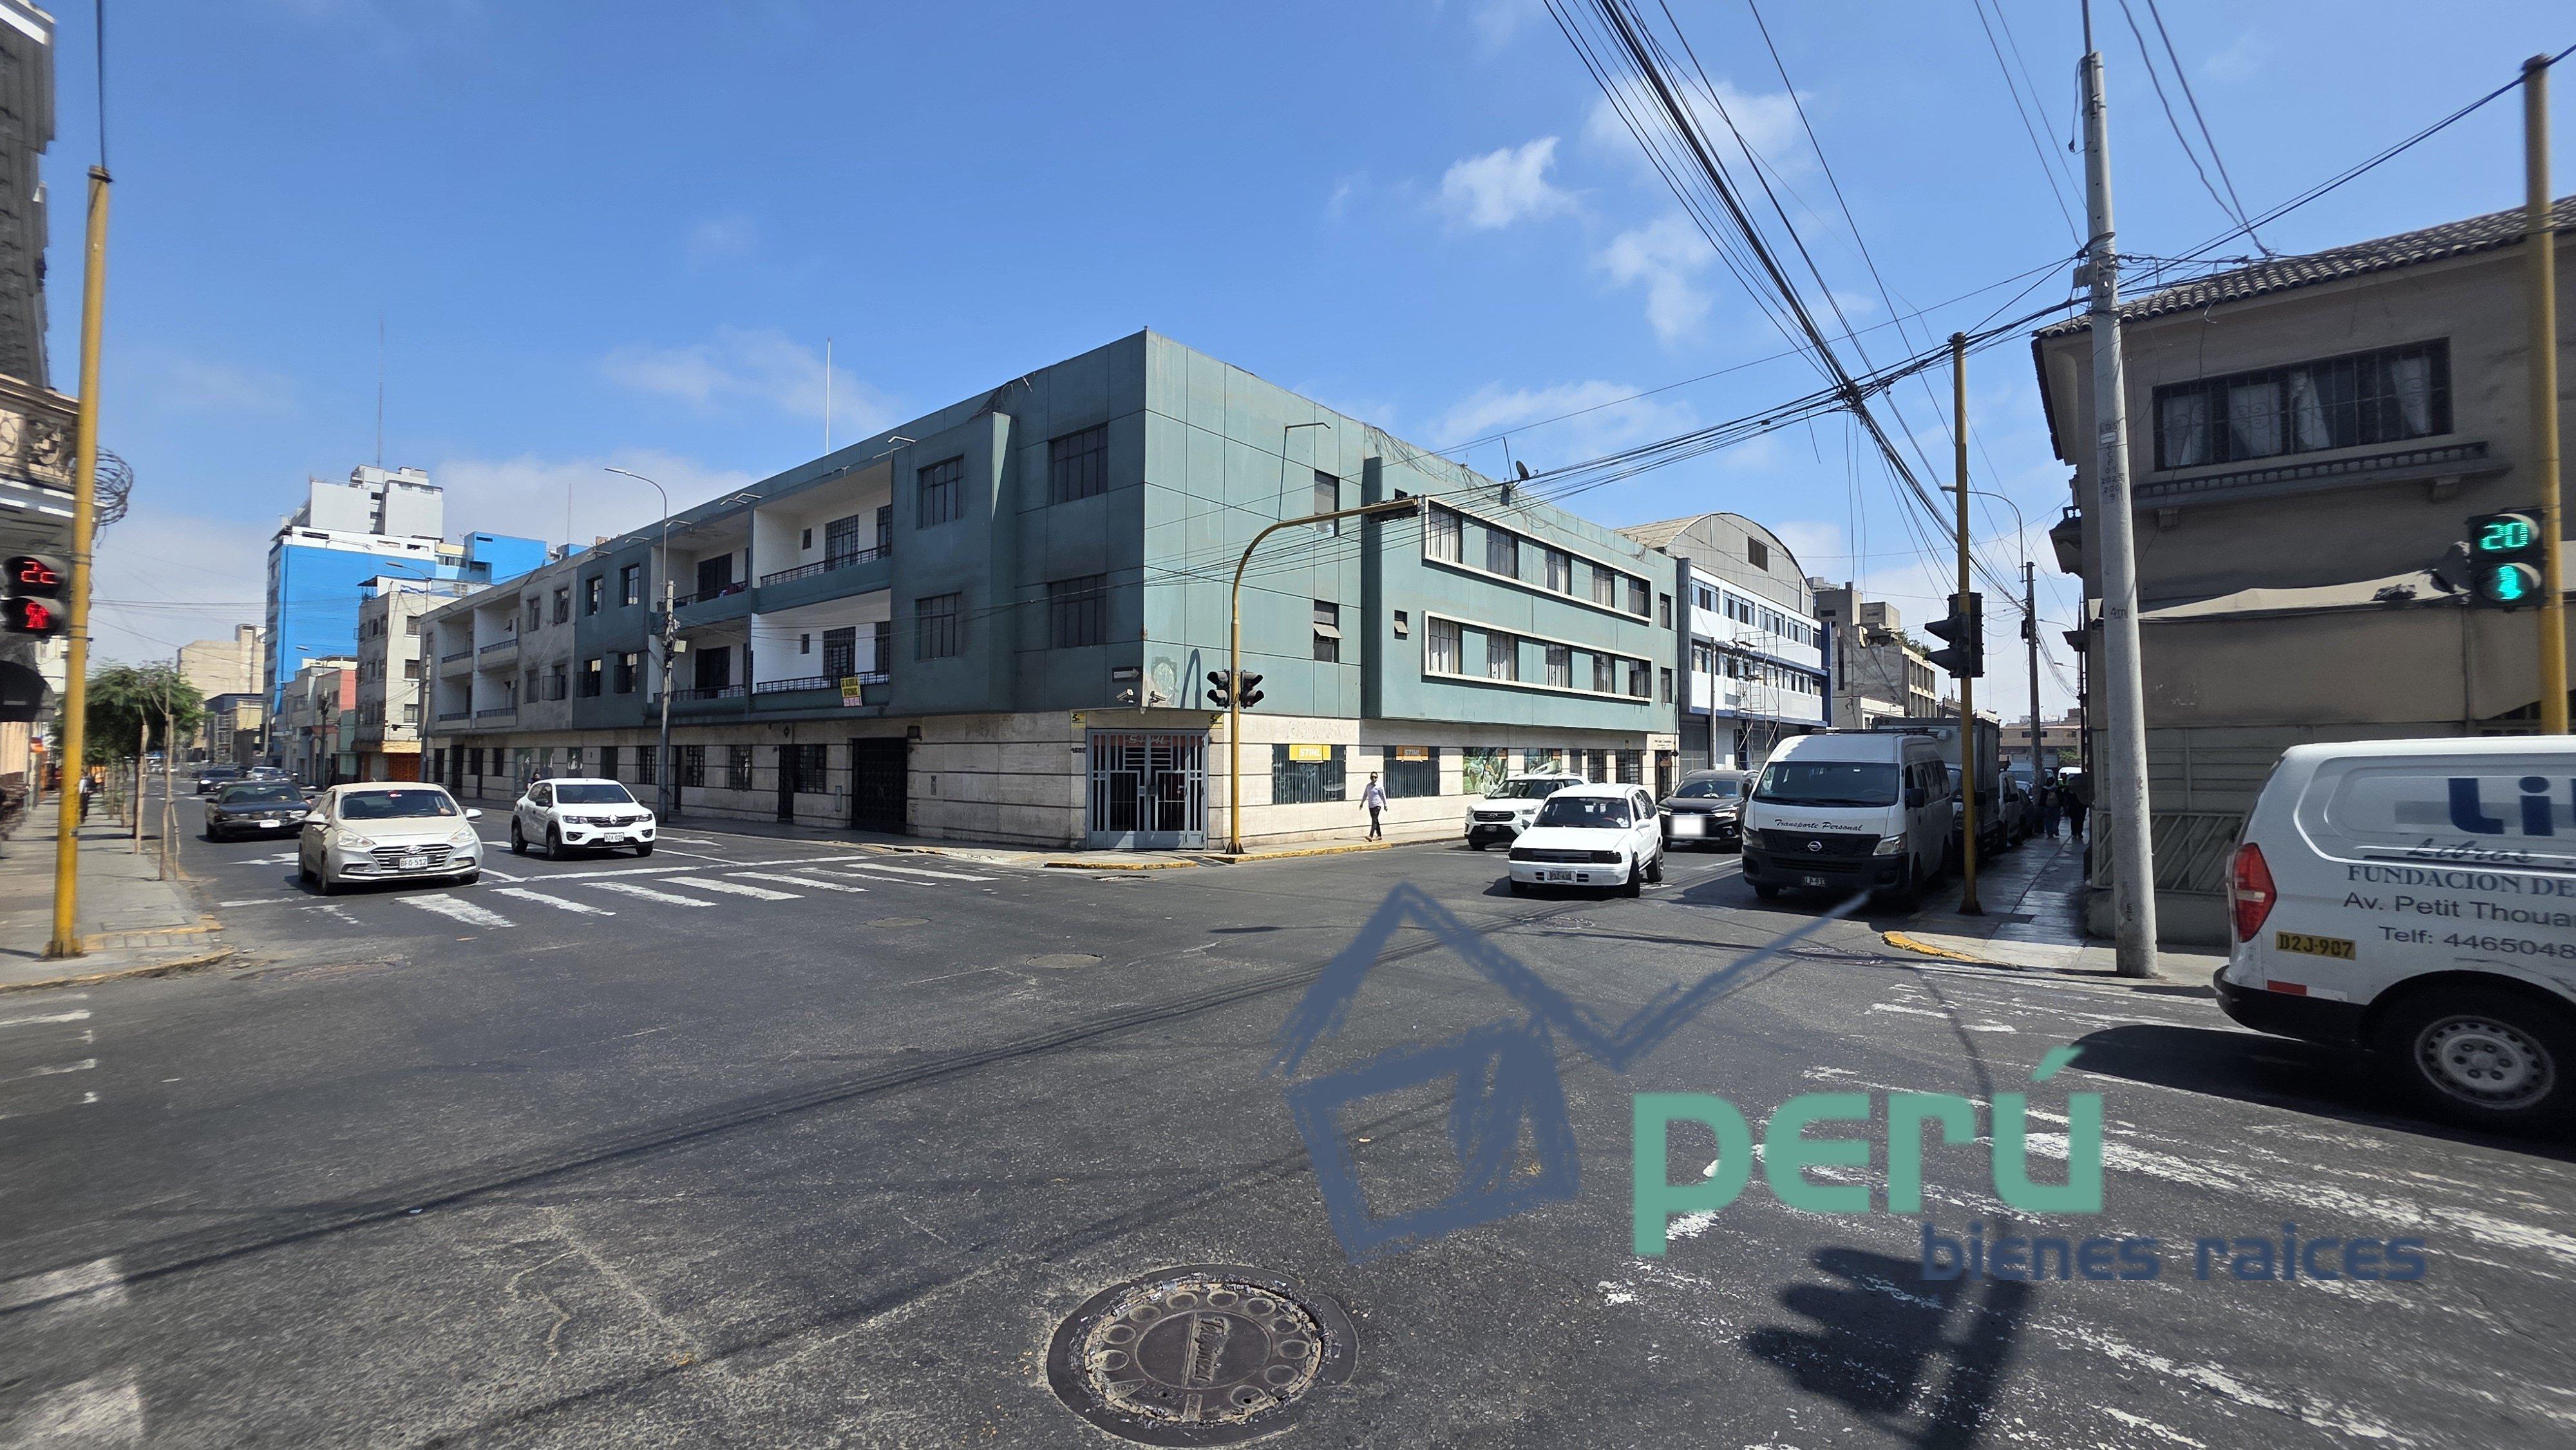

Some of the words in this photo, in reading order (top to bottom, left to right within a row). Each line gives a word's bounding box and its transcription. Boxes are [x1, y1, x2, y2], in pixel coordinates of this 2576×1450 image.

[2480, 522, 2528, 549] 20
[1299, 748, 1321, 757] STIHL
[2448, 776, 2576, 836] Li
[1774, 819, 1819, 829] Transporte
[1822, 822, 1863, 831] Personal
[2347, 865, 2521, 894] FUNDACION
[2343, 892, 2383, 910] Av.
[2395, 896, 2461, 918] Petit
[2470, 901, 2576, 927] Thoua
[2378, 925, 2433, 945] Telf:
[2444, 933, 2576, 959] 4465048
